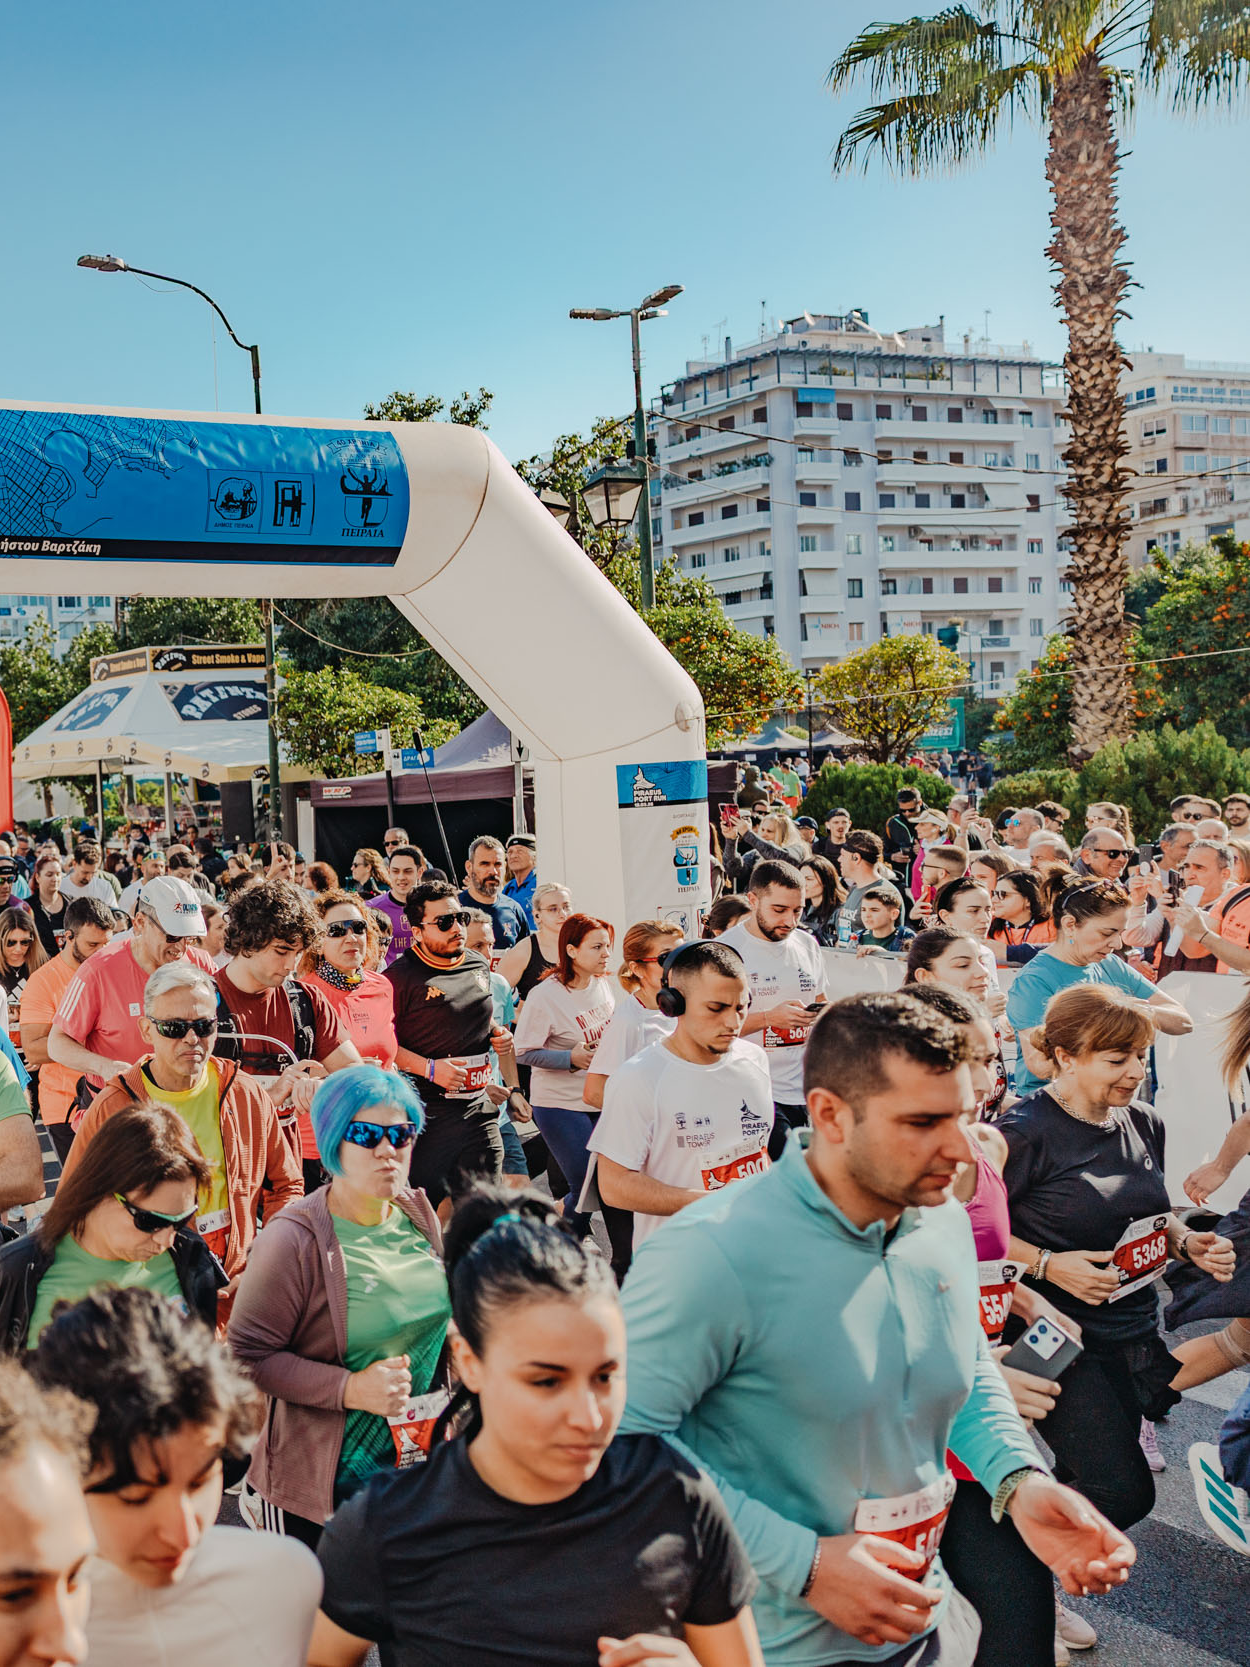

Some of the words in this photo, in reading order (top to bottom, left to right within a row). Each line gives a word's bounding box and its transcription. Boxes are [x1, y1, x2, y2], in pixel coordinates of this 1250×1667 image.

[341, 528, 385, 538] ΠΕΙΡΑΙΑ
[41, 539, 101, 556] Βαρτζάκη
[191, 653, 215, 666] Street
[215, 652, 240, 665] Smoke
[241, 655, 246, 664] &
[247, 653, 266, 665] Vape
[633, 788, 662, 796] PIRAEUS
[634, 795, 652, 803] PORT
[653, 794, 667, 802] RUN
[394, 937, 408, 948] THE
[741, 1121, 769, 1130] PIRAEUS
[686, 1132, 716, 1142] PIRAEUS
[742, 1129, 759, 1137] PORT
[687, 1139, 711, 1149] TOWER
[1132, 1234, 1167, 1270] 5368
[1002, 1266, 1015, 1277] 5K
